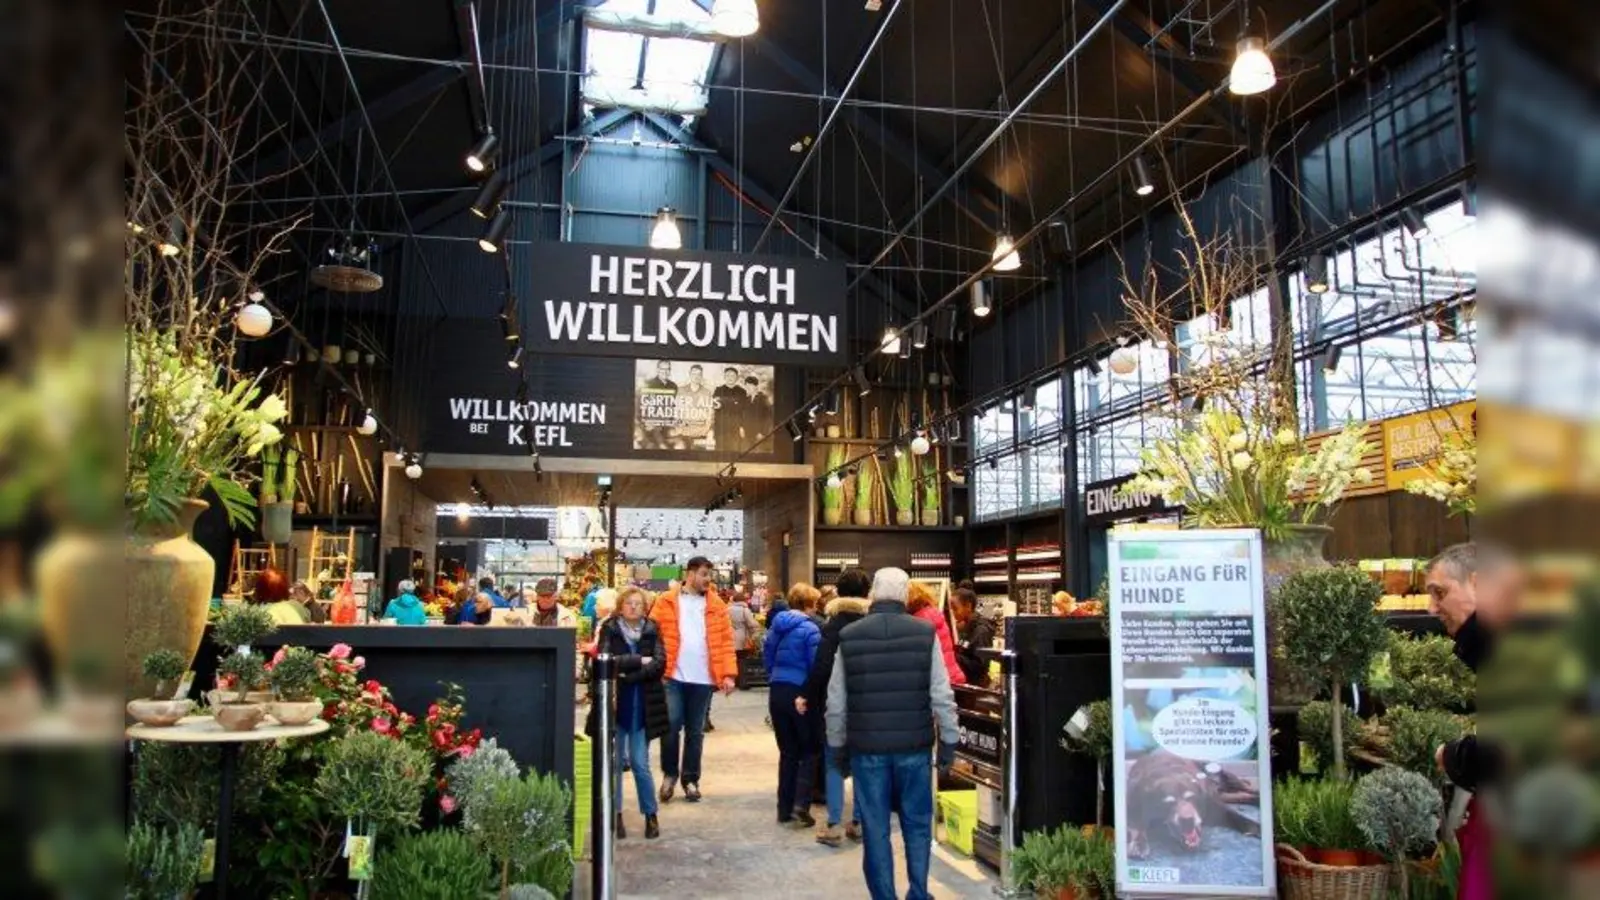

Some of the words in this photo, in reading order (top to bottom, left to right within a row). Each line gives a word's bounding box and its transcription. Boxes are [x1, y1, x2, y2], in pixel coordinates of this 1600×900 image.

[590, 255, 795, 305] HERZLICH
[545, 300, 837, 352] WILLKOMMEN
[697, 396, 722, 409] AUS
[469, 423, 488, 434] BEI
[508, 424, 573, 446] KEFL
[1121, 566, 1206, 582] EINGANG
[1121, 588, 1186, 604] HUNDE
